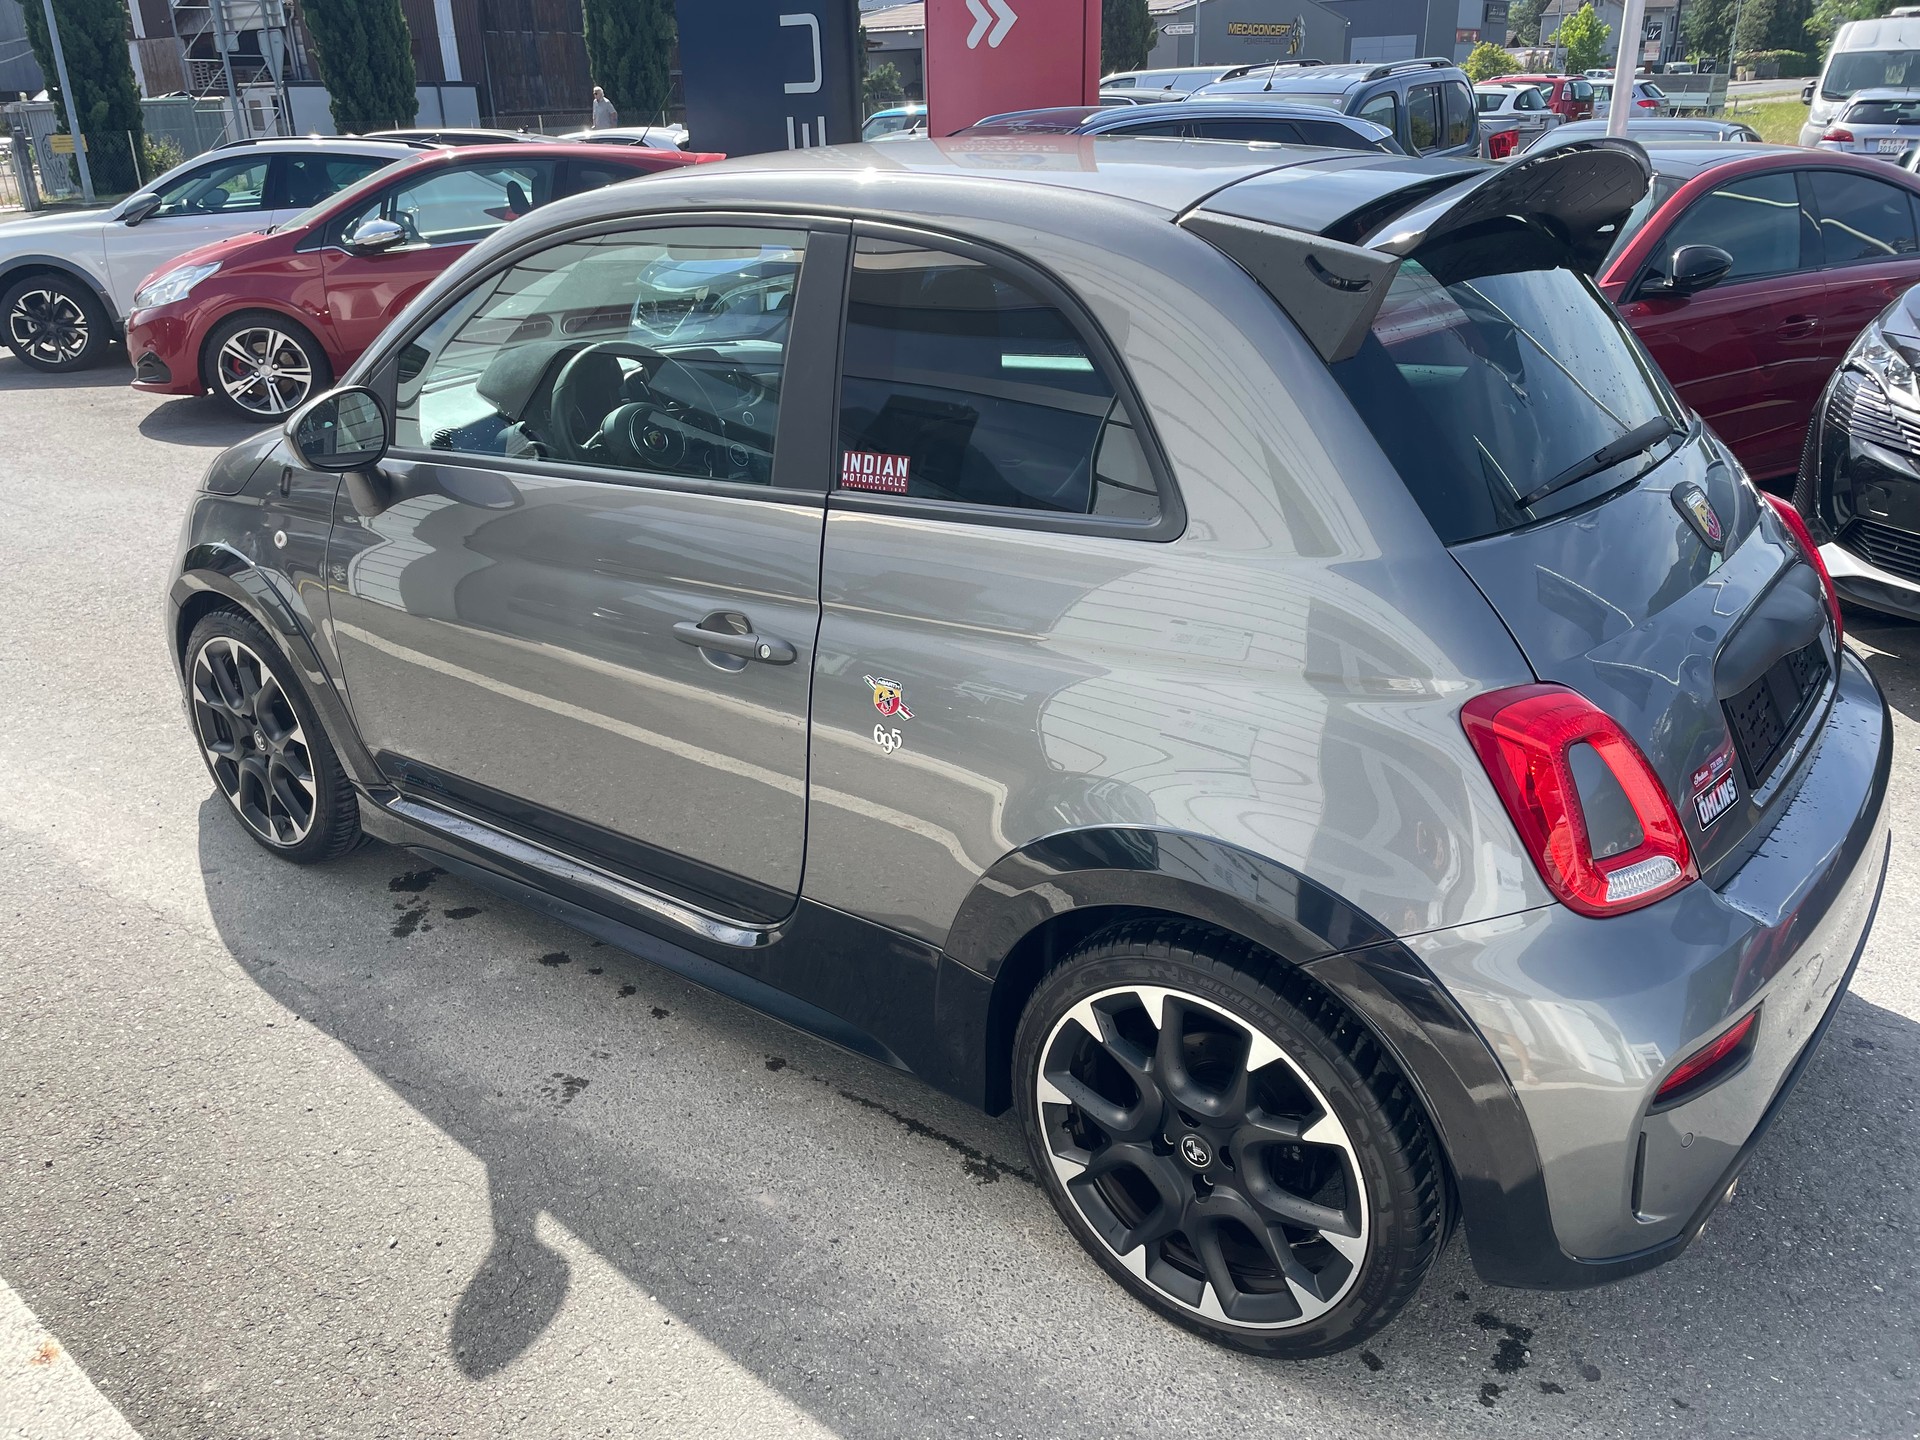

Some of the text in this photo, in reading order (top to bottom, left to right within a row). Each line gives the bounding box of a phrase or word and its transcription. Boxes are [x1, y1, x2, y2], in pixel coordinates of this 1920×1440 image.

[1228, 22, 1291, 36] MECACONCEPT
[843, 452, 908, 477] INDIAN
[842, 473, 907, 487] MOTORCYCLE
[873, 723, 903, 754] 695
[1697, 777, 1737, 824] ÖHLINS
[1198, 979, 1278, 1026] MICHELIN
